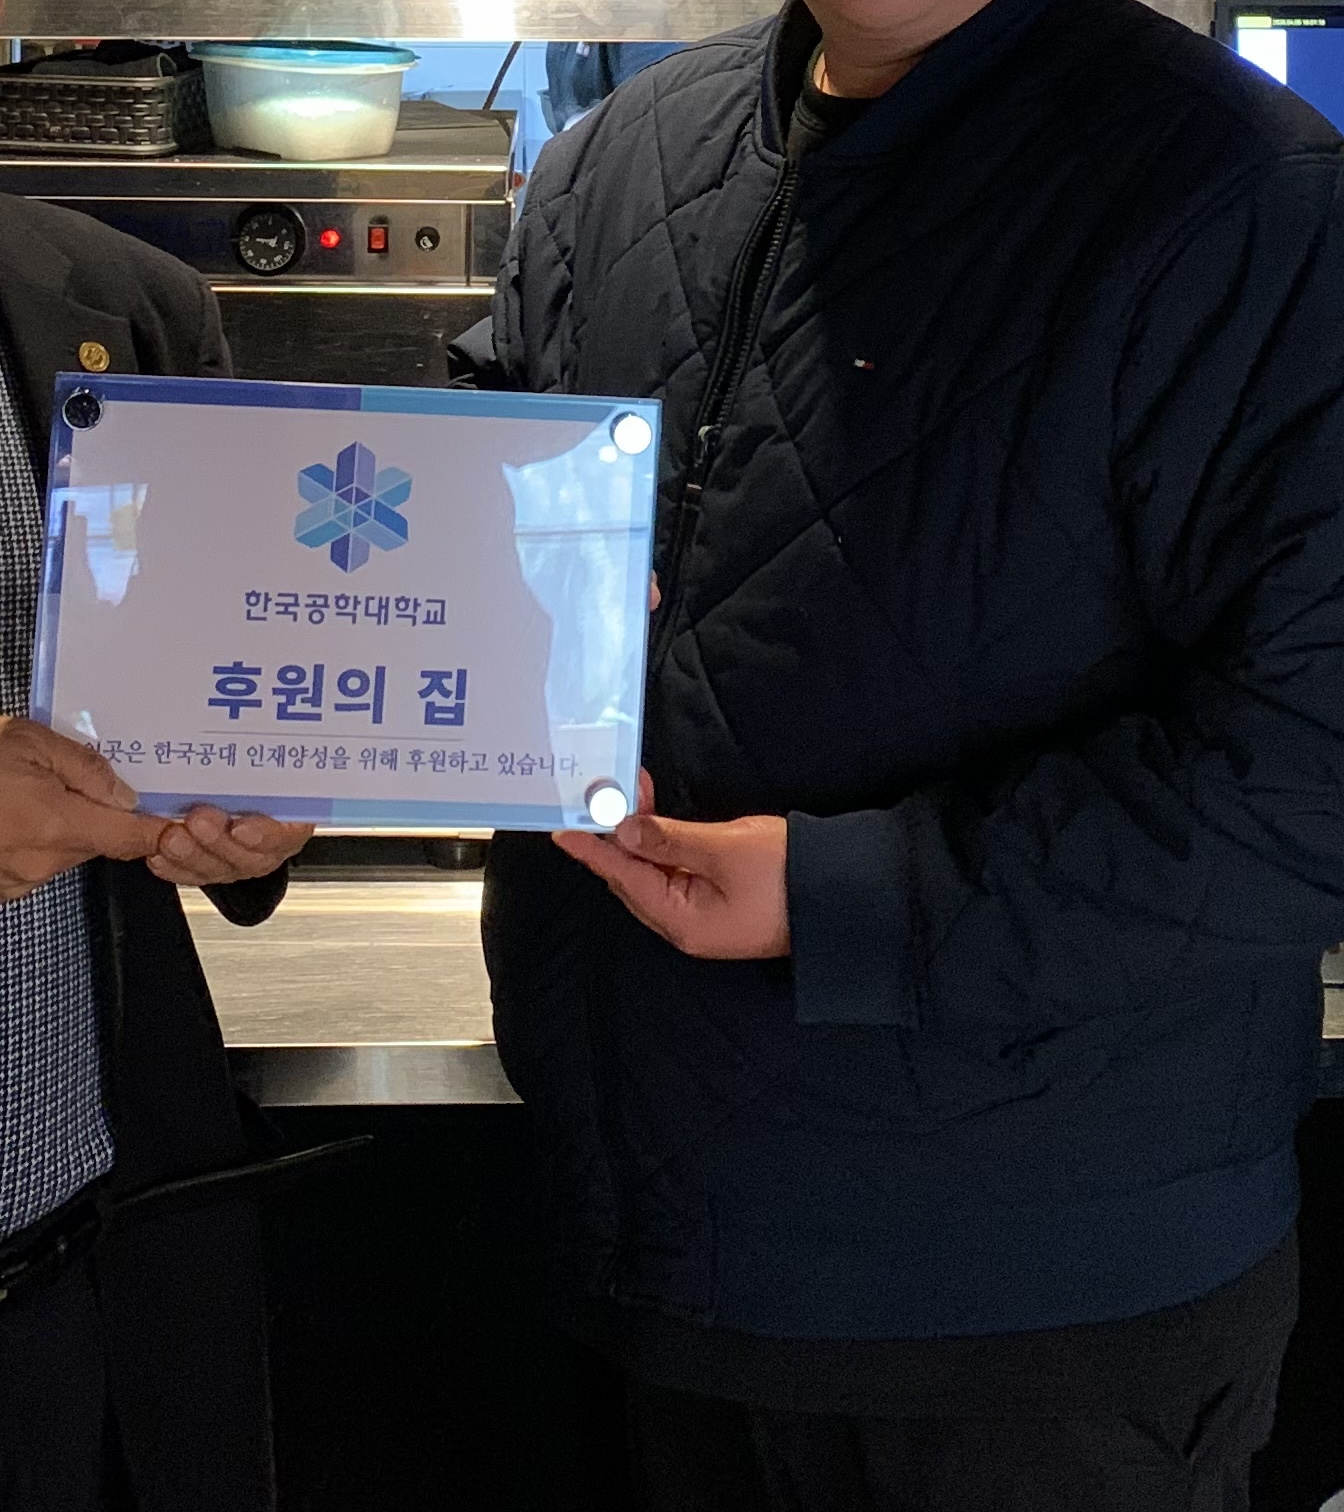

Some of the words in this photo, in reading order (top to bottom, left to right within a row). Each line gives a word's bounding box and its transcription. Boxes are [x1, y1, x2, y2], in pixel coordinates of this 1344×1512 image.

[243, 589, 448, 627] 한국공학대학교
[206, 660, 387, 725] 후원의
[417, 667, 469, 727] 집
[153, 741, 237, 767] 한국공대
[246, 744, 351, 771] 인재양성을
[358, 746, 399, 772] 위해
[406, 748, 489, 774] 후원하고
[497, 751, 584, 778] 있습니다.
